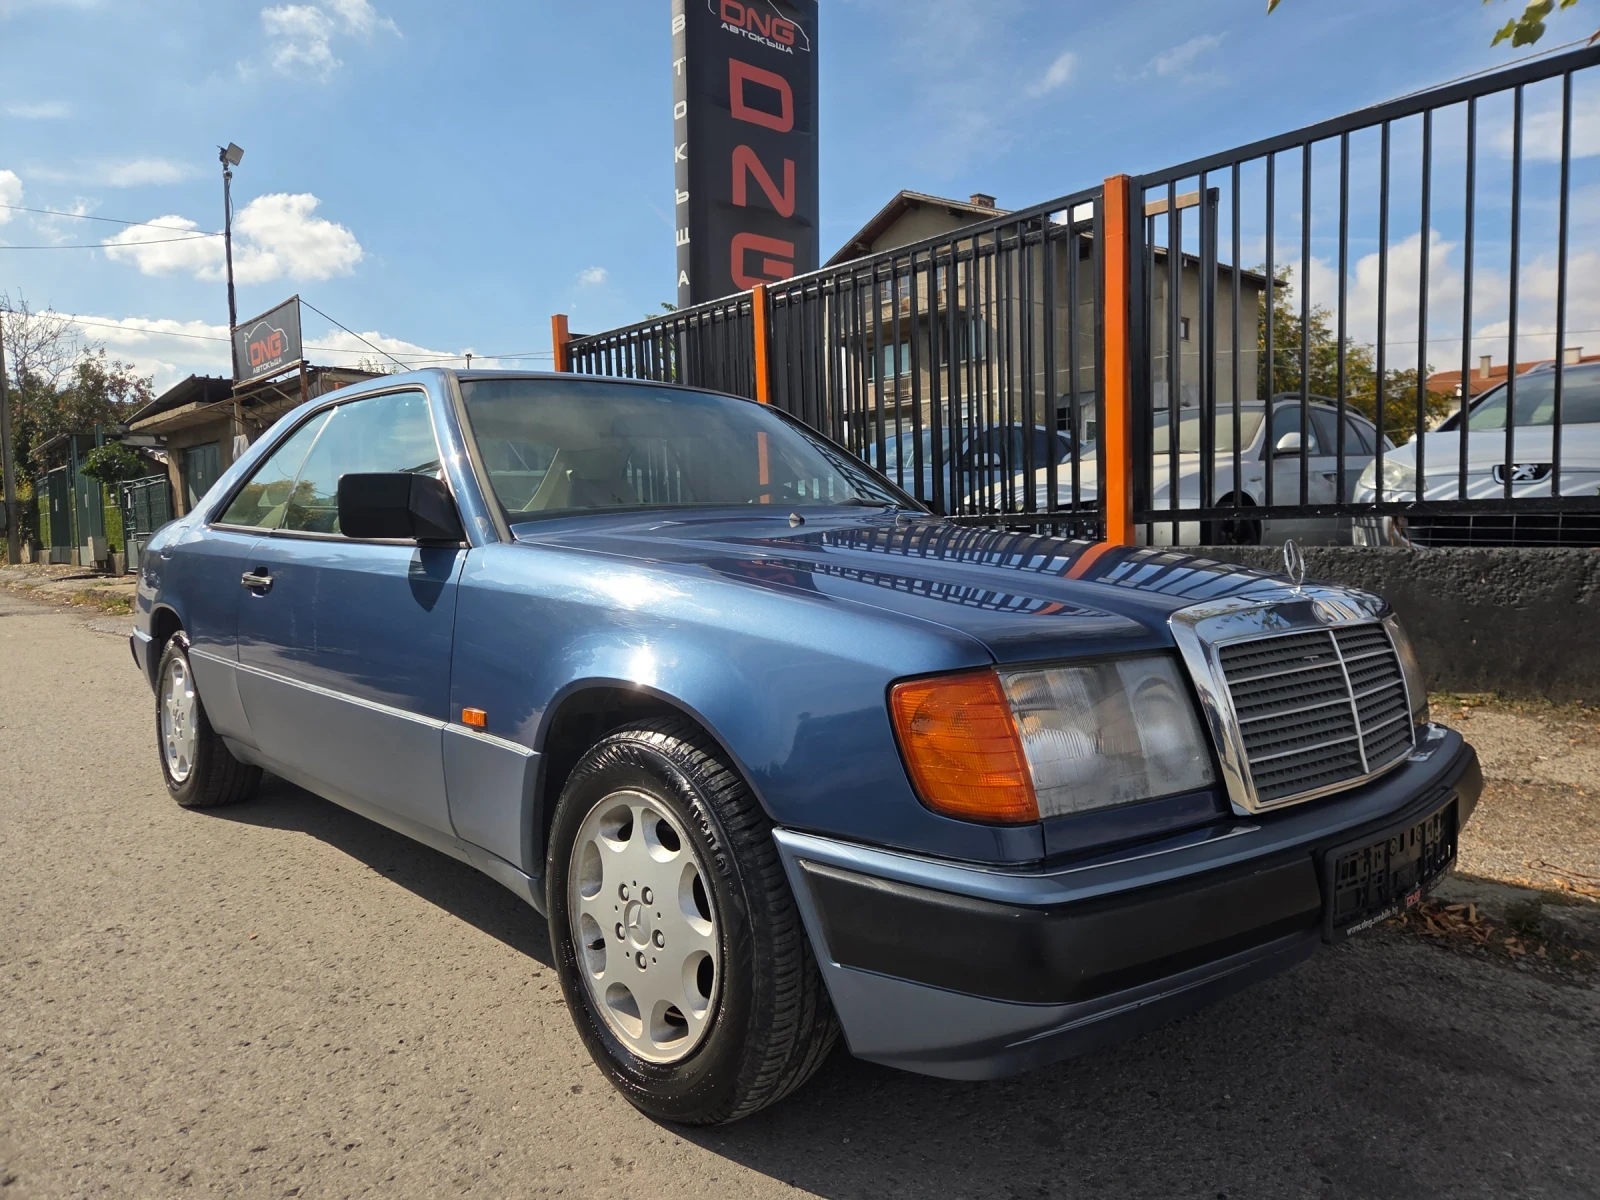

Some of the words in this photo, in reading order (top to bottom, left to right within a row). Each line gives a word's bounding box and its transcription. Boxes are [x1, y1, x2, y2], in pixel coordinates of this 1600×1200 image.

[720, 0, 795, 46] DNG
[721, 22, 793, 55] АВТОКЪЩА
[728, 57, 795, 291] DNG
[250, 331, 282, 366] DNG
